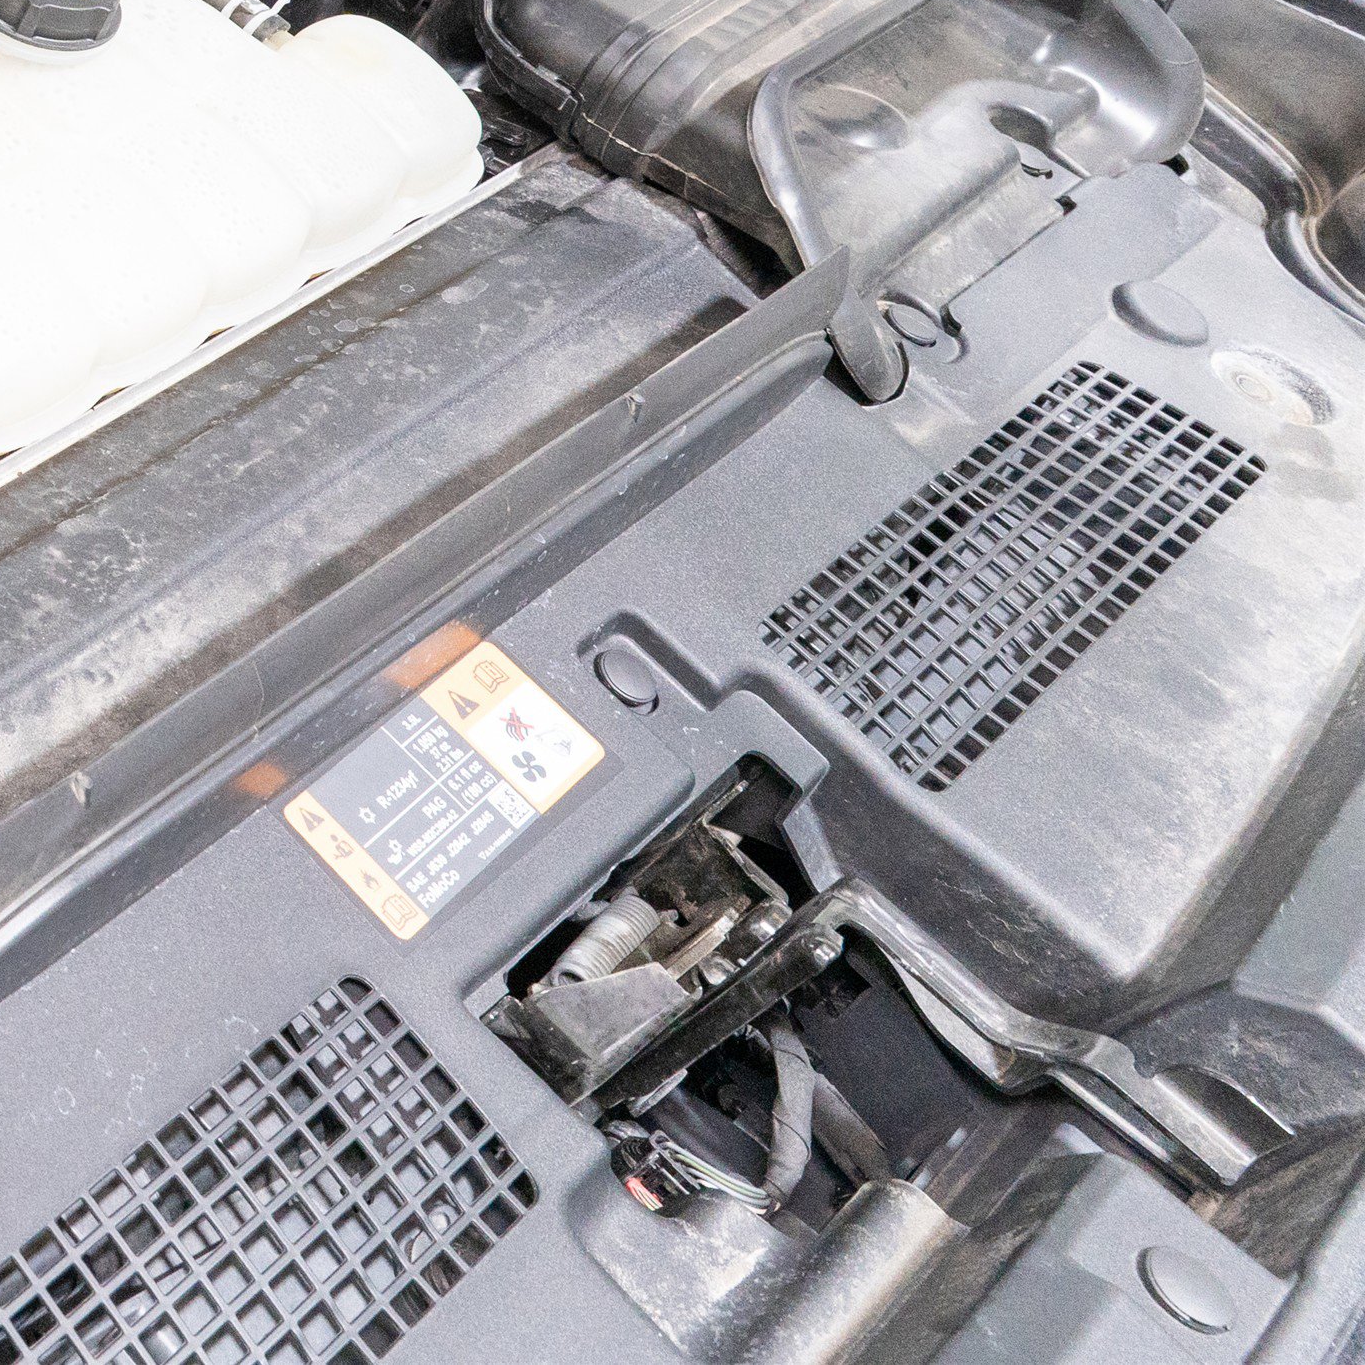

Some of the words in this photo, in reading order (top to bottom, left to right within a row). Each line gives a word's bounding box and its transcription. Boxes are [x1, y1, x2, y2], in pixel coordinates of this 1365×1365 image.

[430, 723, 449, 741] kg
[429, 748, 442, 759] 37
[467, 760, 482, 774] oz
[375, 769, 421, 812] R-1234yf
[421, 795, 447, 819] PAG
[405, 872, 428, 893] SAE
[416, 867, 461, 908] FoMoCo
